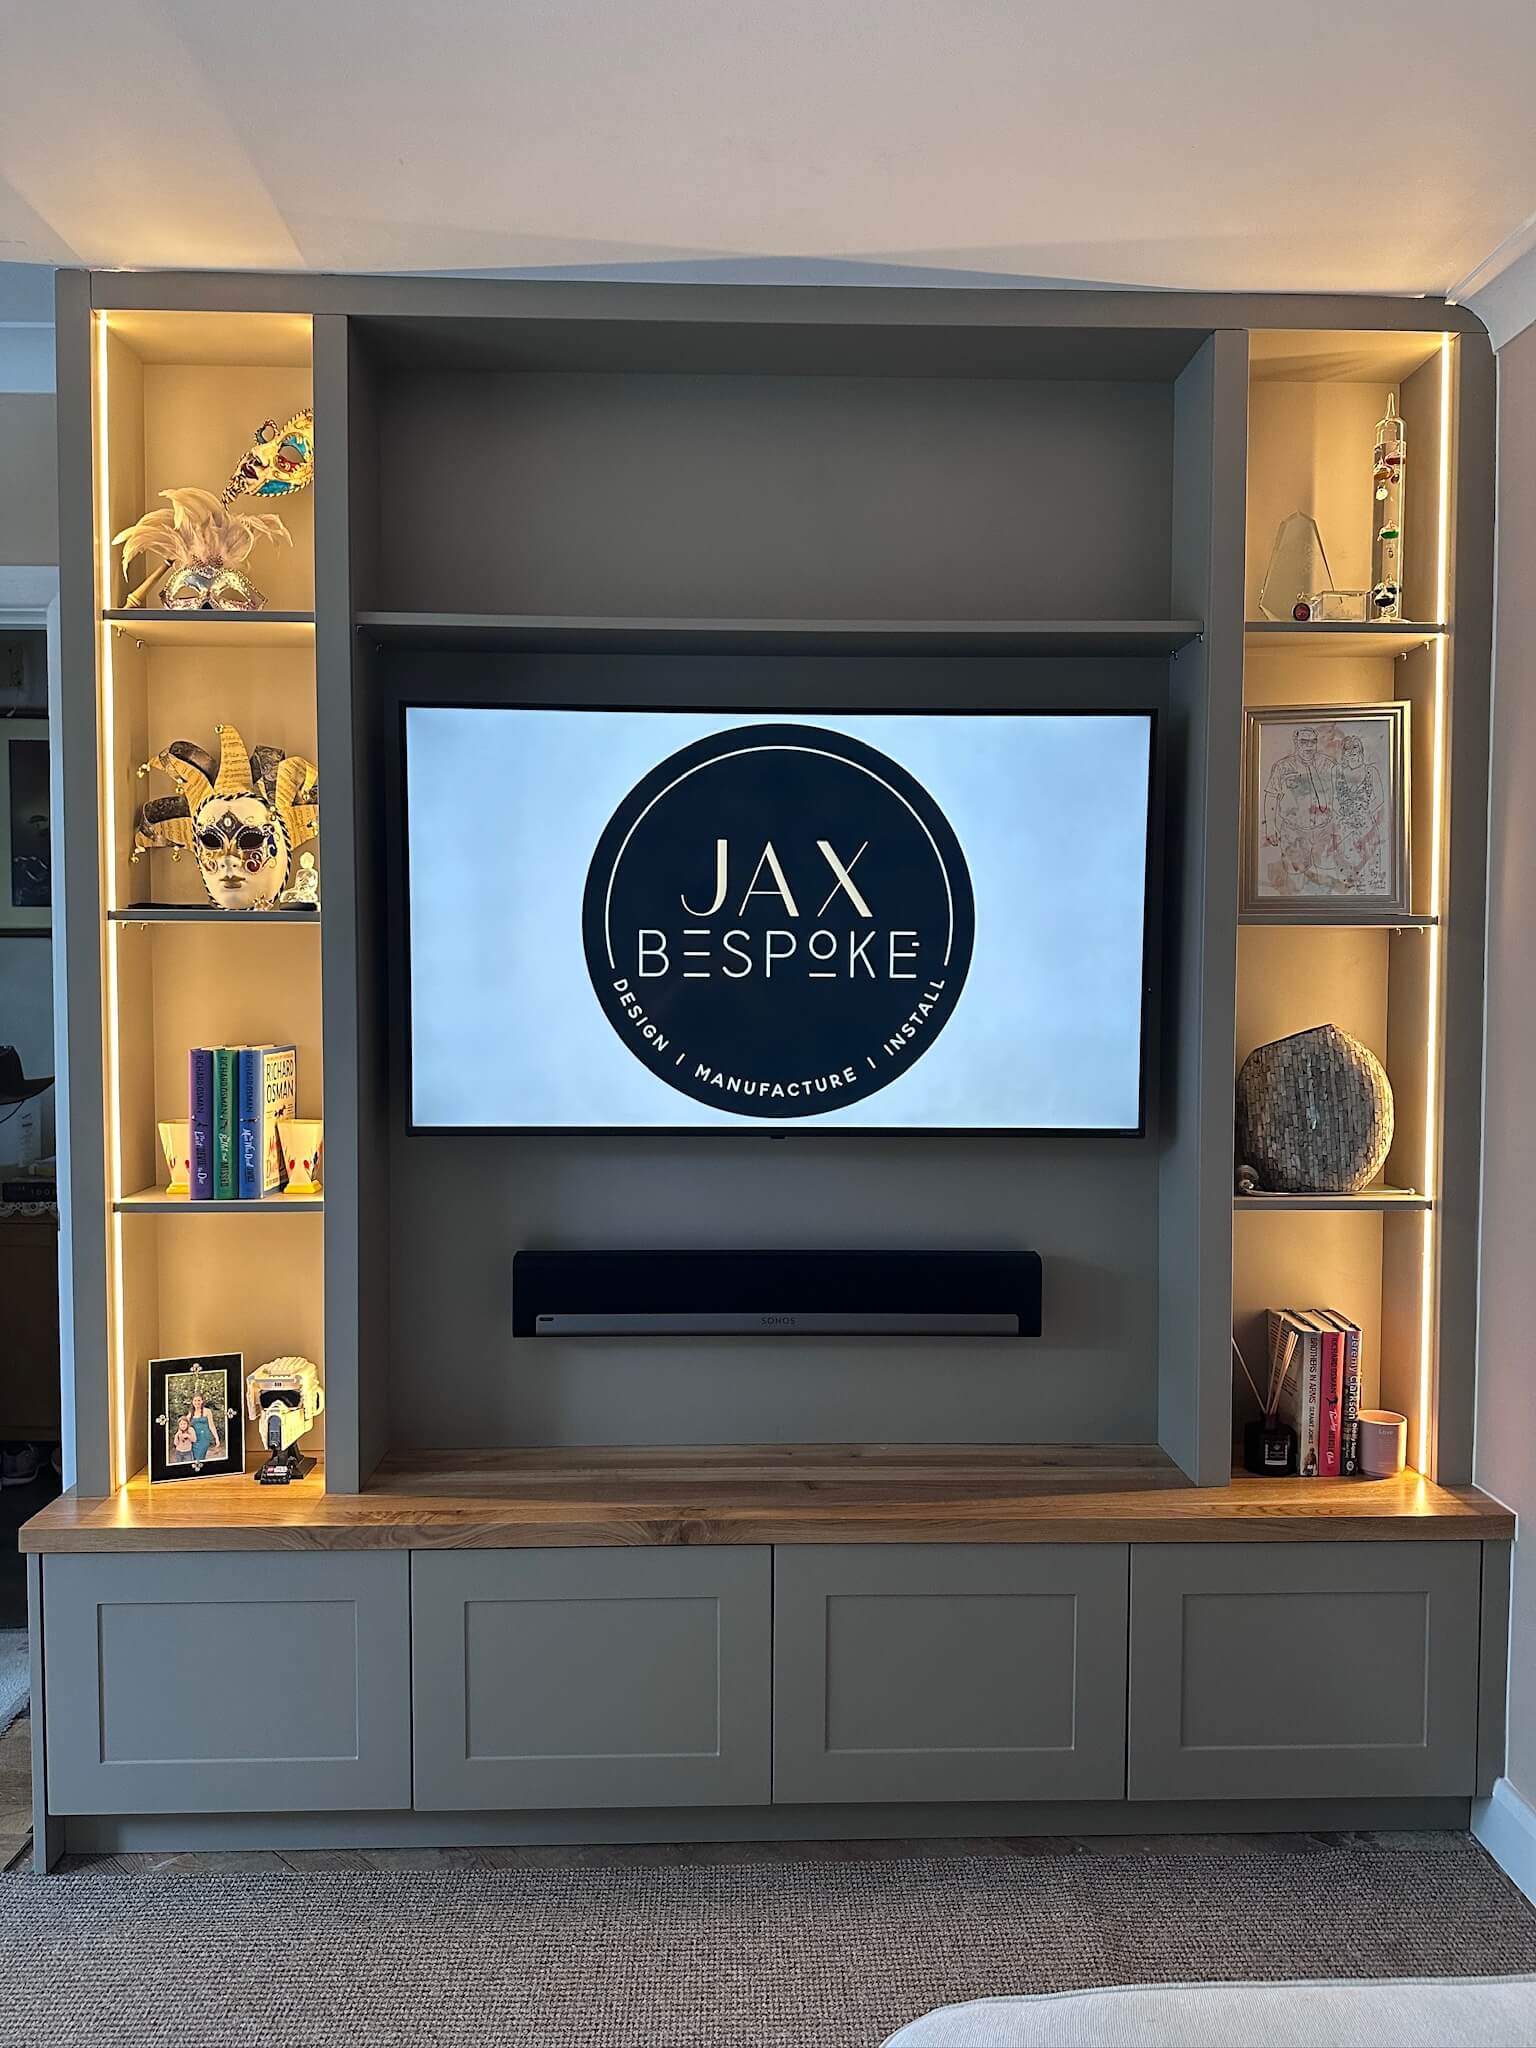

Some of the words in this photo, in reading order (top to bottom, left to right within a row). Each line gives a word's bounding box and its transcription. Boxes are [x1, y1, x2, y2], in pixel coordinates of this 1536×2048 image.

[681, 839, 873, 917] JAX
[638, 929, 920, 979] BESPOKE
[613, 978, 670, 1052] DESIGN
[694, 1063, 857, 1098] MANUFACTURE
[883, 977, 945, 1056] INSTALL
[219, 1056, 228, 1086] RICHARD
[266, 1060, 294, 1081] RICHARD
[219, 1087, 228, 1116] OSMAN
[266, 1080, 294, 1103] OSMAN
[760, 1316, 797, 1326] SONOS
[1309, 1337, 1317, 1373] BROTHERS
[1349, 1336, 1360, 1373] Jeremy
[1308, 1382, 1317, 1404] ARMS
[1348, 1376, 1358, 1420] Clarkson
